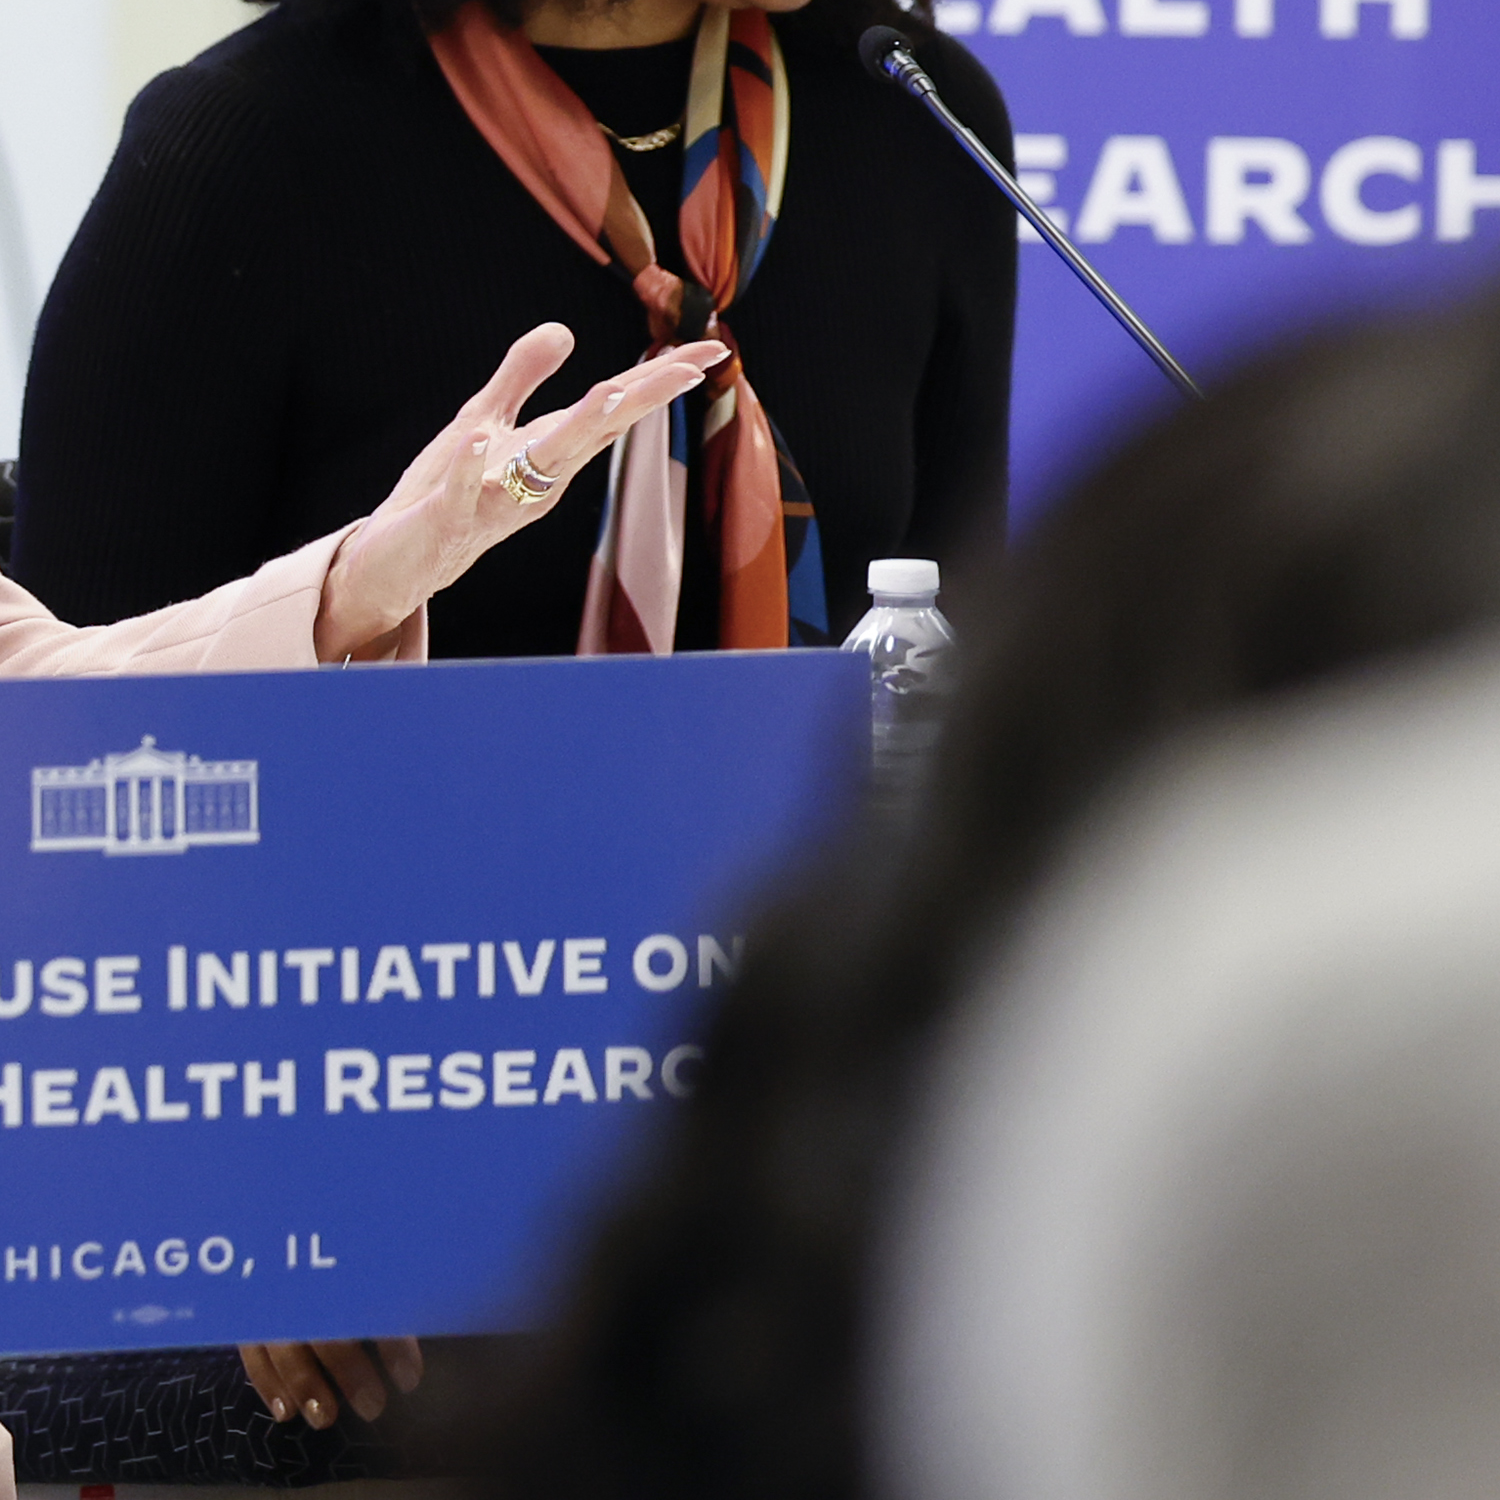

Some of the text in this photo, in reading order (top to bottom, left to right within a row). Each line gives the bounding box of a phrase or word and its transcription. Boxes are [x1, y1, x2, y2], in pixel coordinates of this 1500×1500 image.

[167, 937, 609, 1011] INITIATIVE
[631, 933, 743, 992] ON
[286, 1232, 339, 1270] IL
